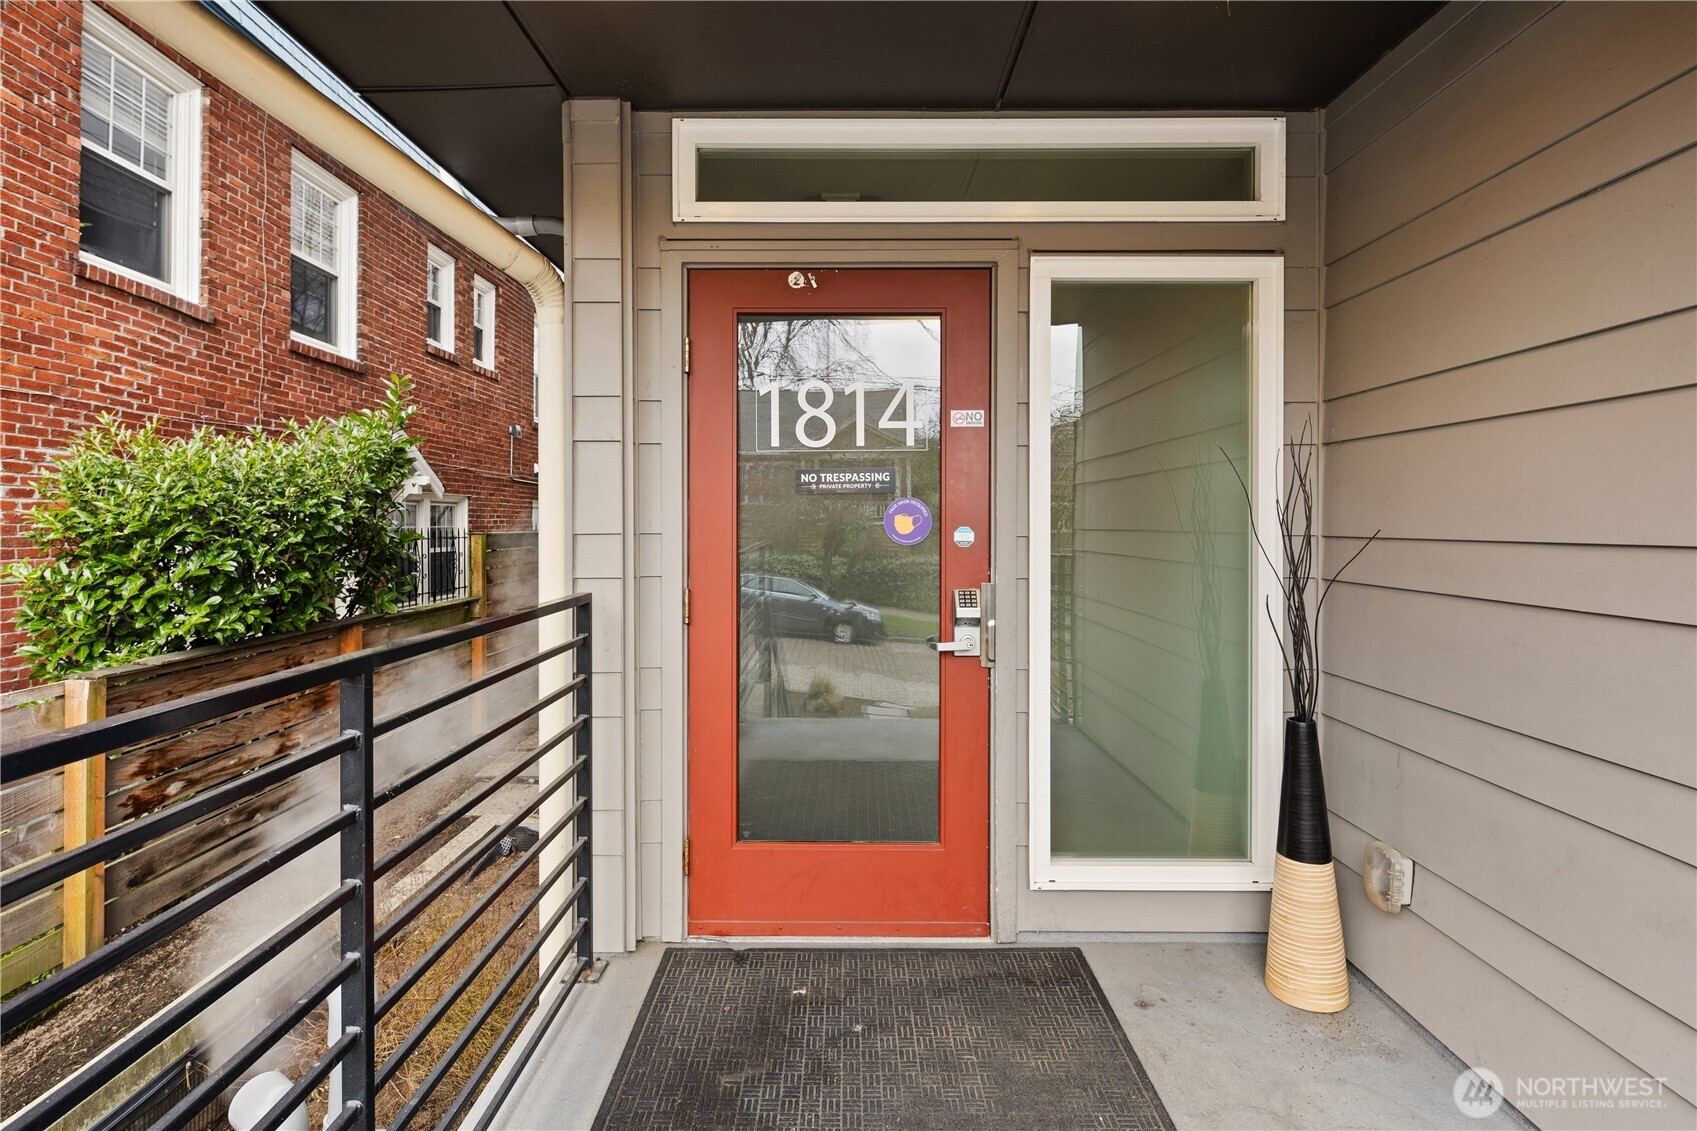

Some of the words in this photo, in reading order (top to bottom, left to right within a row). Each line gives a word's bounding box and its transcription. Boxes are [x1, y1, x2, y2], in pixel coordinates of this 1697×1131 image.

[759, 380, 922, 448] 1814
[965, 412, 982, 421] NO
[801, 474, 817, 483] NO
[820, 472, 890, 482] TRESPASSING
